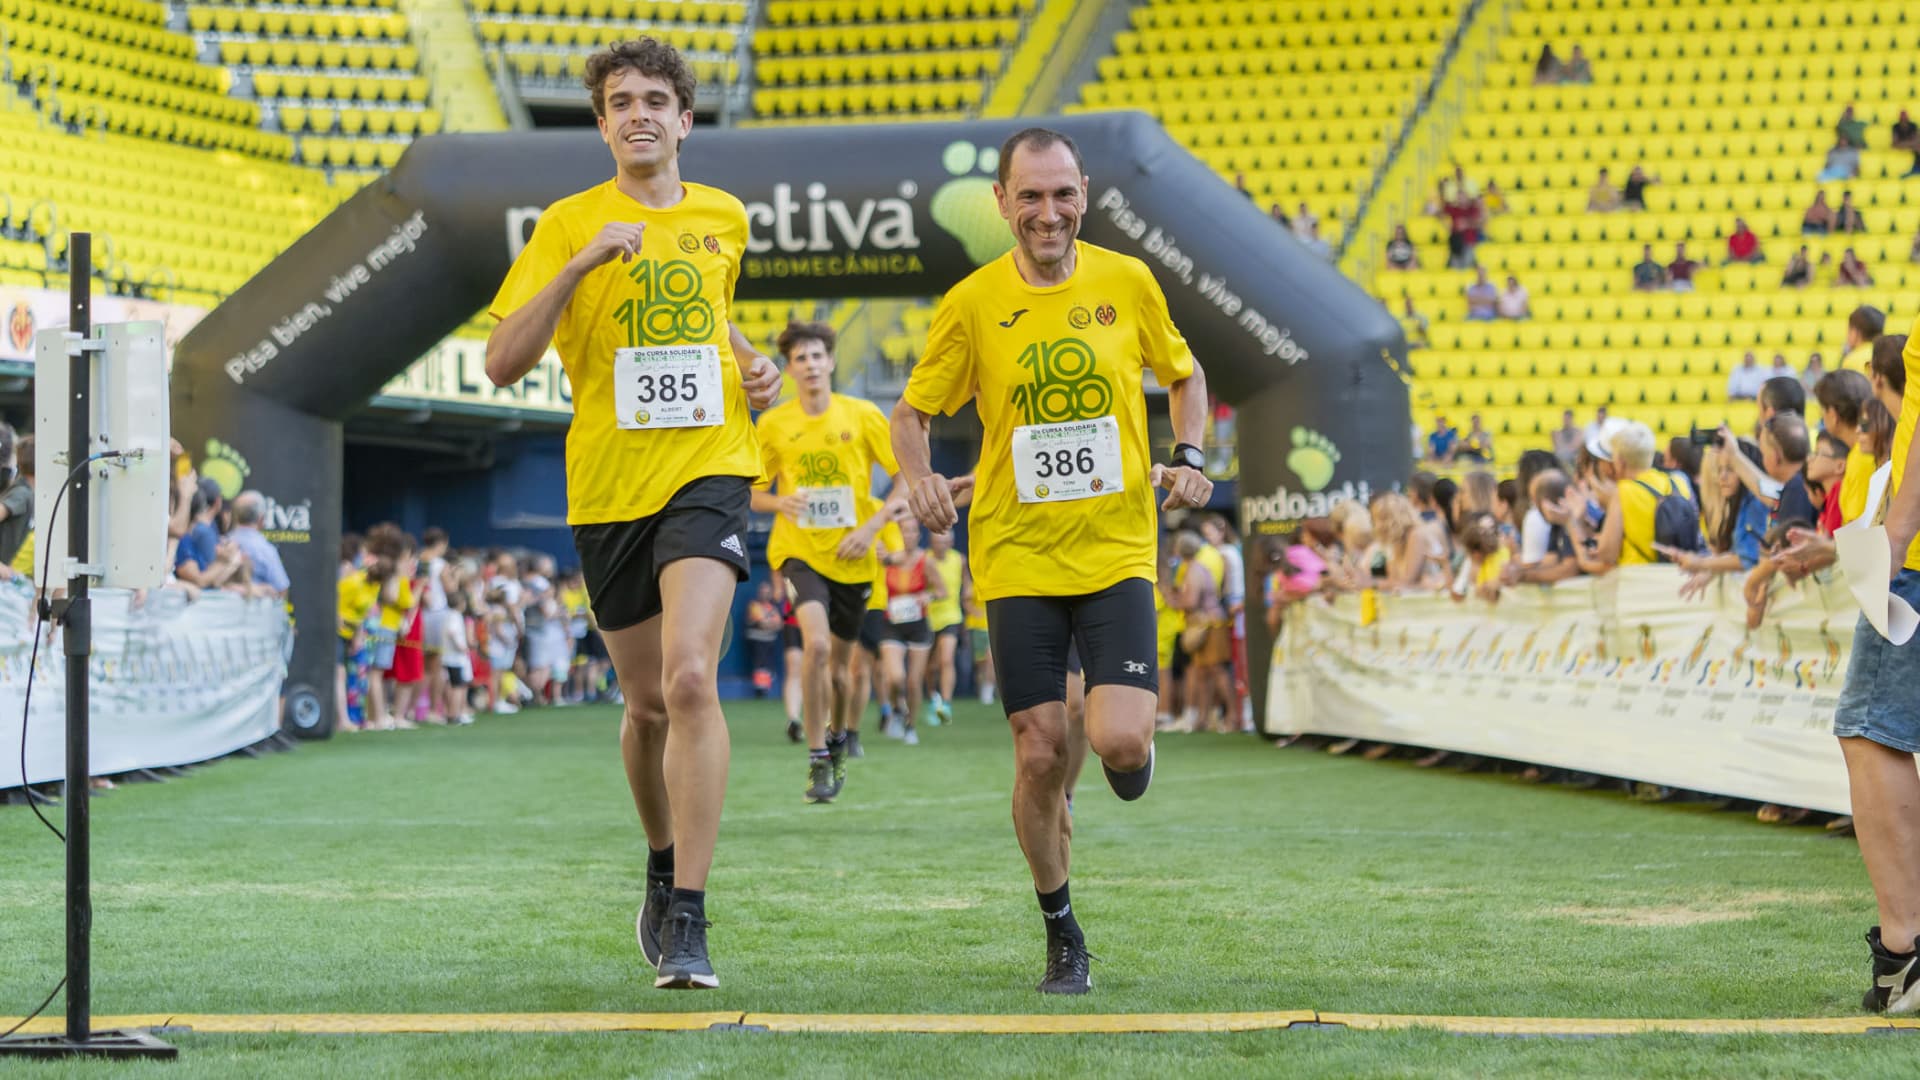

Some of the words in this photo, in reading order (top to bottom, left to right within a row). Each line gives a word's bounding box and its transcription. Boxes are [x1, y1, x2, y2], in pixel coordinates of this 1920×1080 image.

[506, 180, 920, 263] pctiva
[629, 259, 703, 305] 10
[746, 252, 924, 279] BIOMECÁNICA
[1096, 186, 1147, 240] Pisa
[1142, 226, 1194, 285] bien,
[1197, 271, 1243, 317] vive
[1238, 307, 1309, 366] mejor
[224, 339, 279, 384] Pisa
[269, 301, 332, 347] bien,
[324, 263, 371, 303] vive
[366, 208, 428, 272] mejor
[1016, 337, 1097, 384] 10
[637, 373, 698, 403] 385
[1041, 426, 1063, 434] CURSA
[1034, 447, 1094, 478] 386
[808, 501, 840, 516] 169
